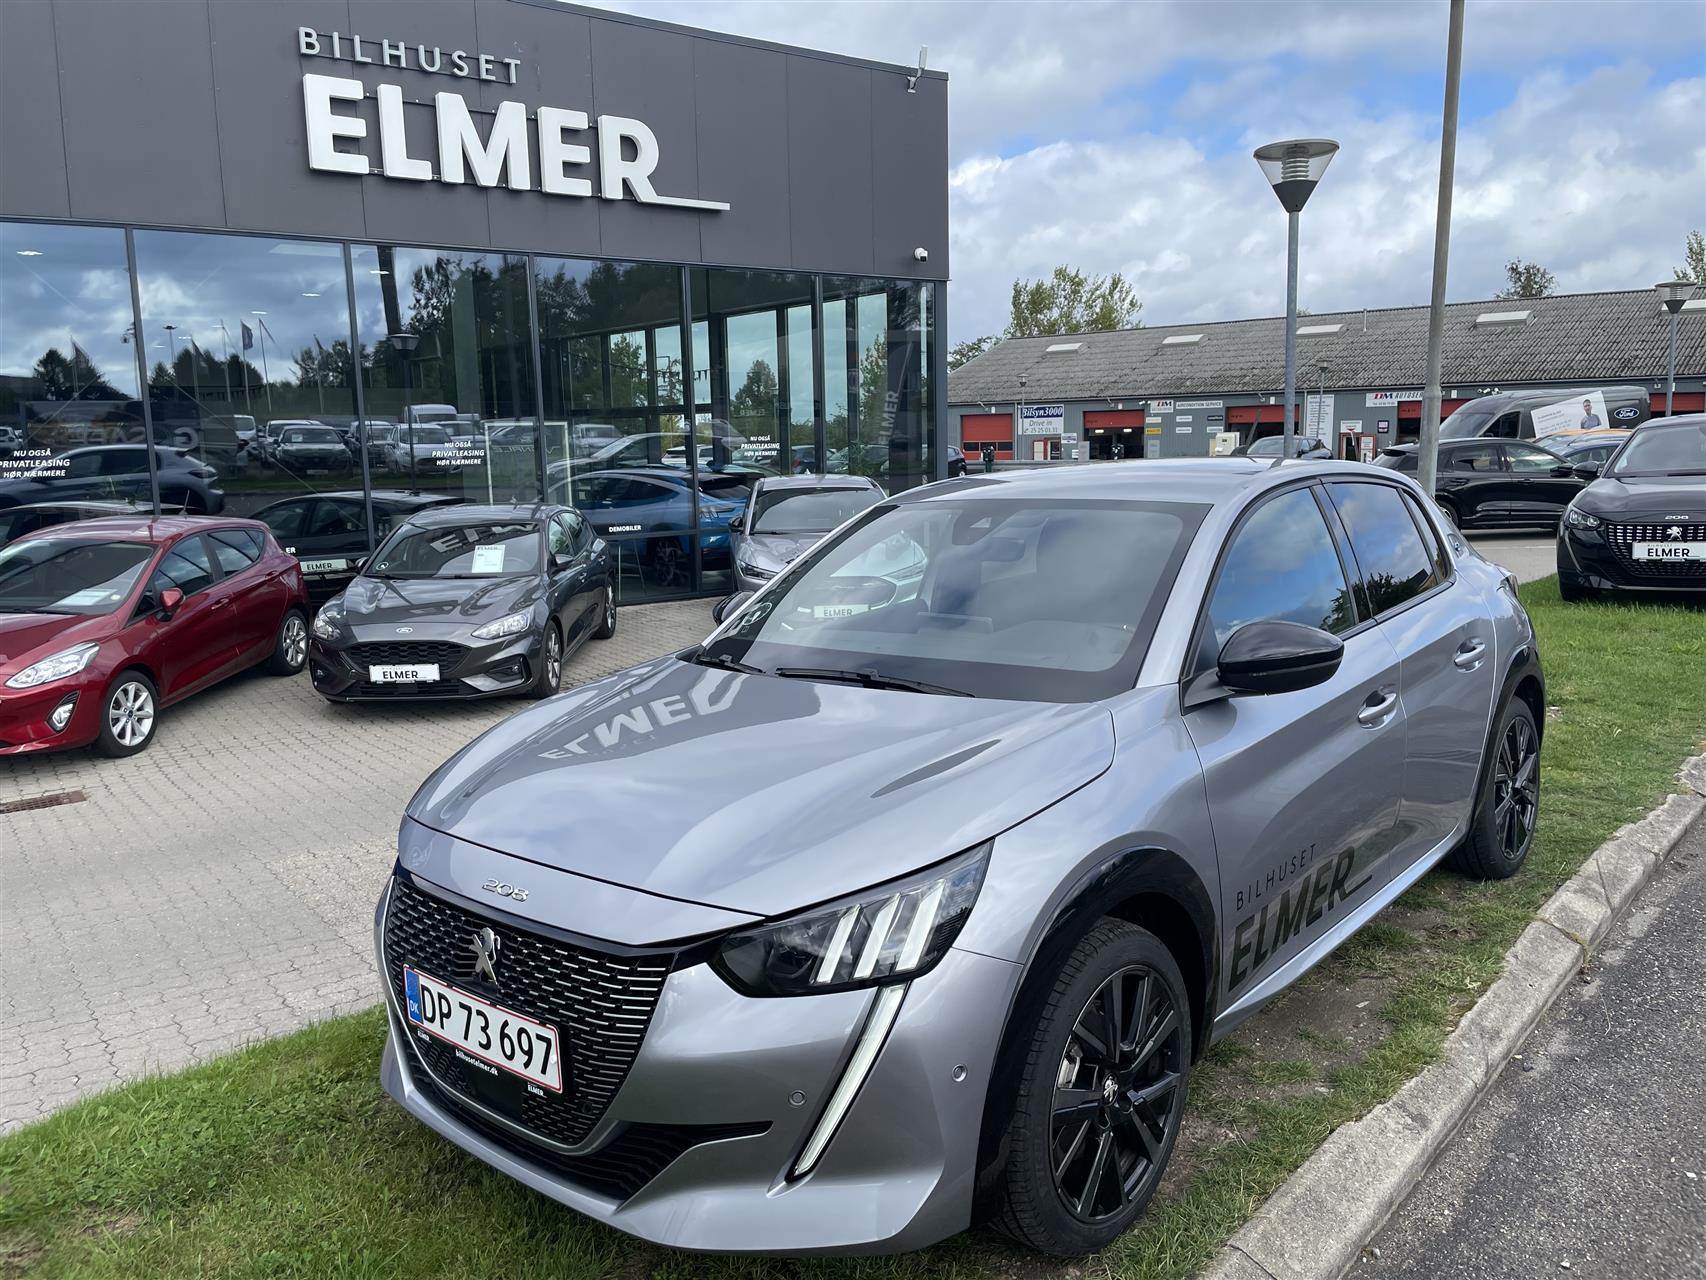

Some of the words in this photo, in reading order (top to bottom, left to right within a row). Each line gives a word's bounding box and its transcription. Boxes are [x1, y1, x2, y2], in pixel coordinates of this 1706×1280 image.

[299, 27, 521, 84] BILHUSET
[303, 73, 731, 211] ELMER
[455, 440, 471, 448] OGSÅ
[13, 449, 26, 457] NU
[28, 447, 52, 457] OGSÅ
[432, 449, 484, 457] PRIVATLEASING
[3, 471, 22, 479] HØR
[23, 469, 66, 478] NÆRMERE
[1647, 547, 1700, 558] ELMER
[306, 562, 333, 571] ELMER
[823, 608, 853, 617] ELMER
[382, 670, 427, 680] ELMER
[1236, 843, 1316, 910] BILHUSET
[481, 878, 529, 902] 208
[1228, 846, 1373, 993] ELMER
[409, 999, 420, 1014] DK
[421, 983, 451, 1031] DP
[459, 1001, 492, 1051] 73
[500, 1019, 552, 1076] 697
